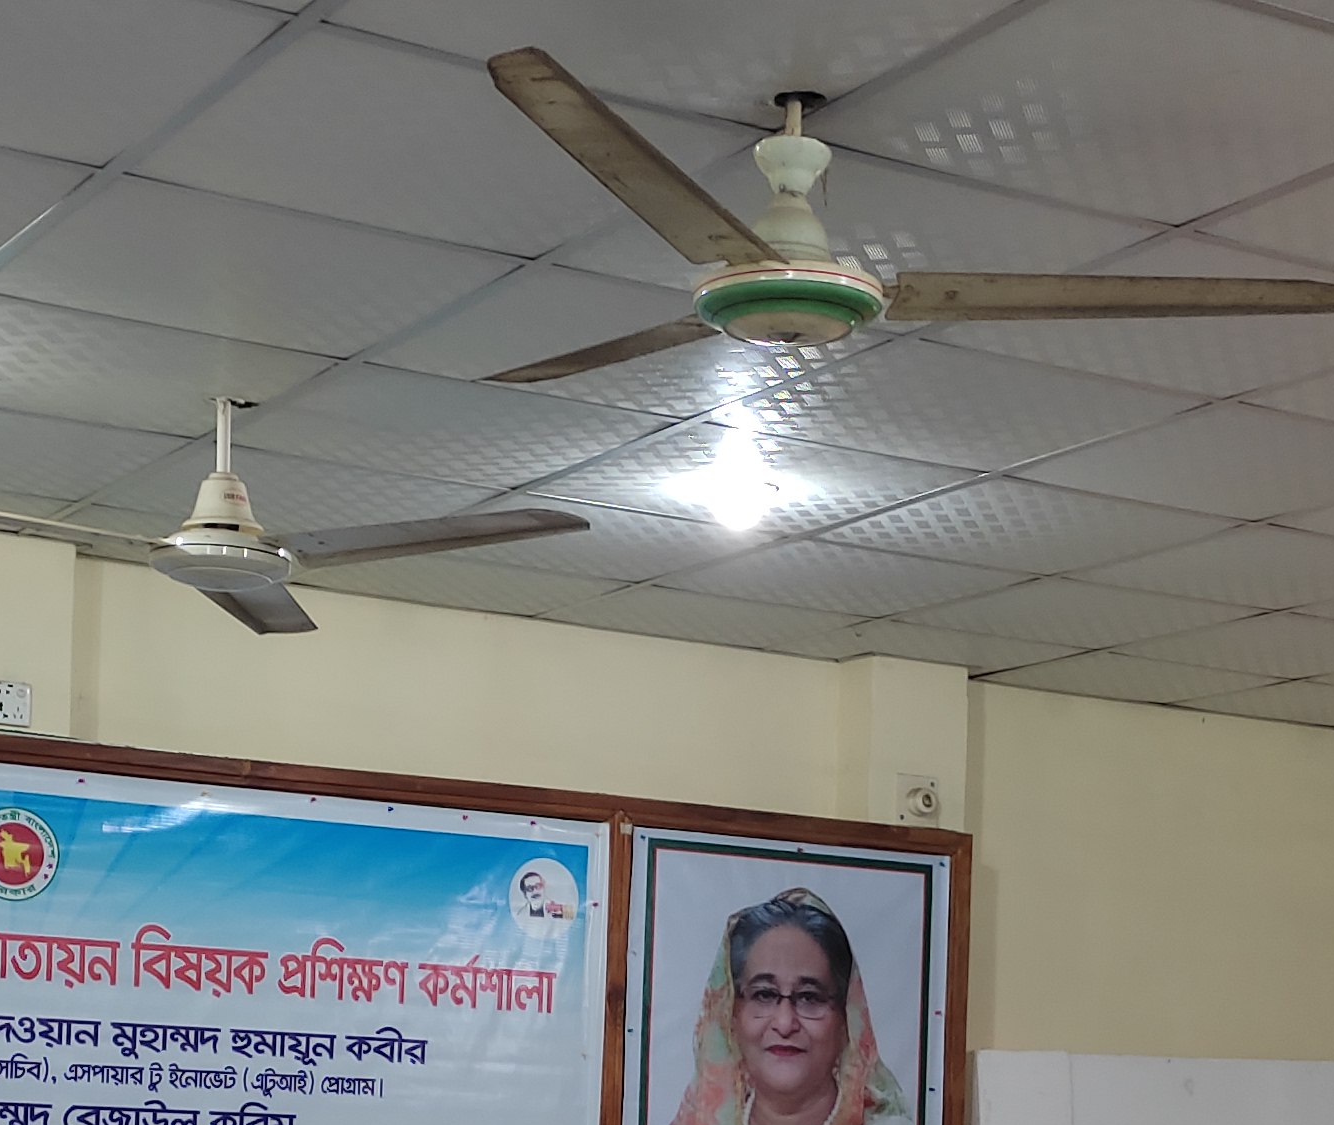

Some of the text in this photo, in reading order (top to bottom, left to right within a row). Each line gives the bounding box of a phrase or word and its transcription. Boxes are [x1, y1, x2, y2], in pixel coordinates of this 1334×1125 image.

[131, 923, 268, 998] বিষয়ক
[278, 936, 408, 1006] প্রশিক্ষণ
[418, 955, 556, 1014] কর্মশালা
[110, 1021, 221, 1060] মুহাম্মদ
[345, 1026, 428, 1065] কবীর
[64, 1061, 144, 1086] এসপায়ার
[149, 1061, 164, 1092] টু
[169, 1062, 238, 1090] ইনোভেট
[243, 1066, 315, 1098] (এটুআই)
